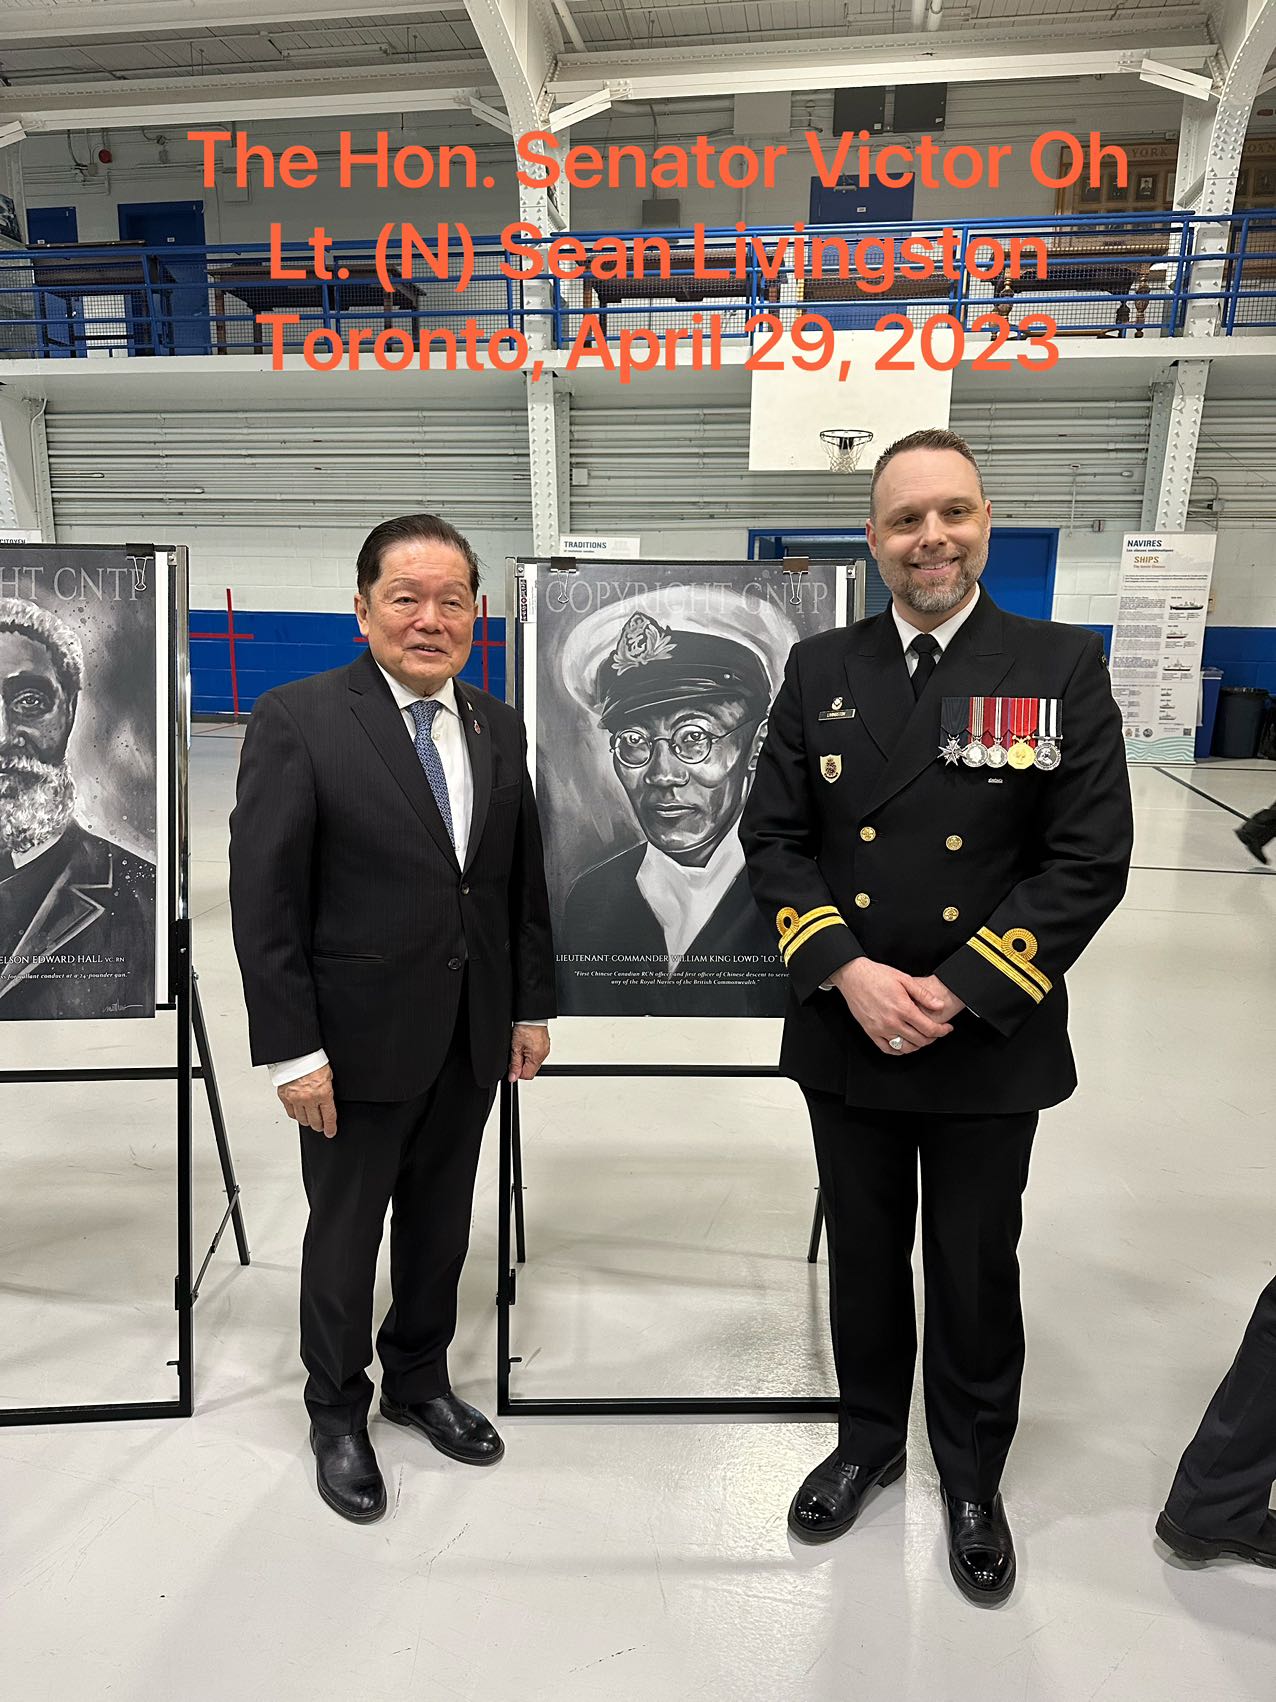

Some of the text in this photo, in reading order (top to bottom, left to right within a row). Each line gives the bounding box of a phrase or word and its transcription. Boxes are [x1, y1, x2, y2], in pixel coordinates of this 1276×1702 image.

[1131, 147, 1168, 158] YORK
[564, 541, 607, 549] TRADITIONS
[545, 581, 733, 613] COPYRIGHT
[740, 582, 828, 614] CNTP
[32, 955, 75, 963] EDWARD
[77, 954, 102, 963] HALL
[671, 954, 708, 962] WILLIAM
